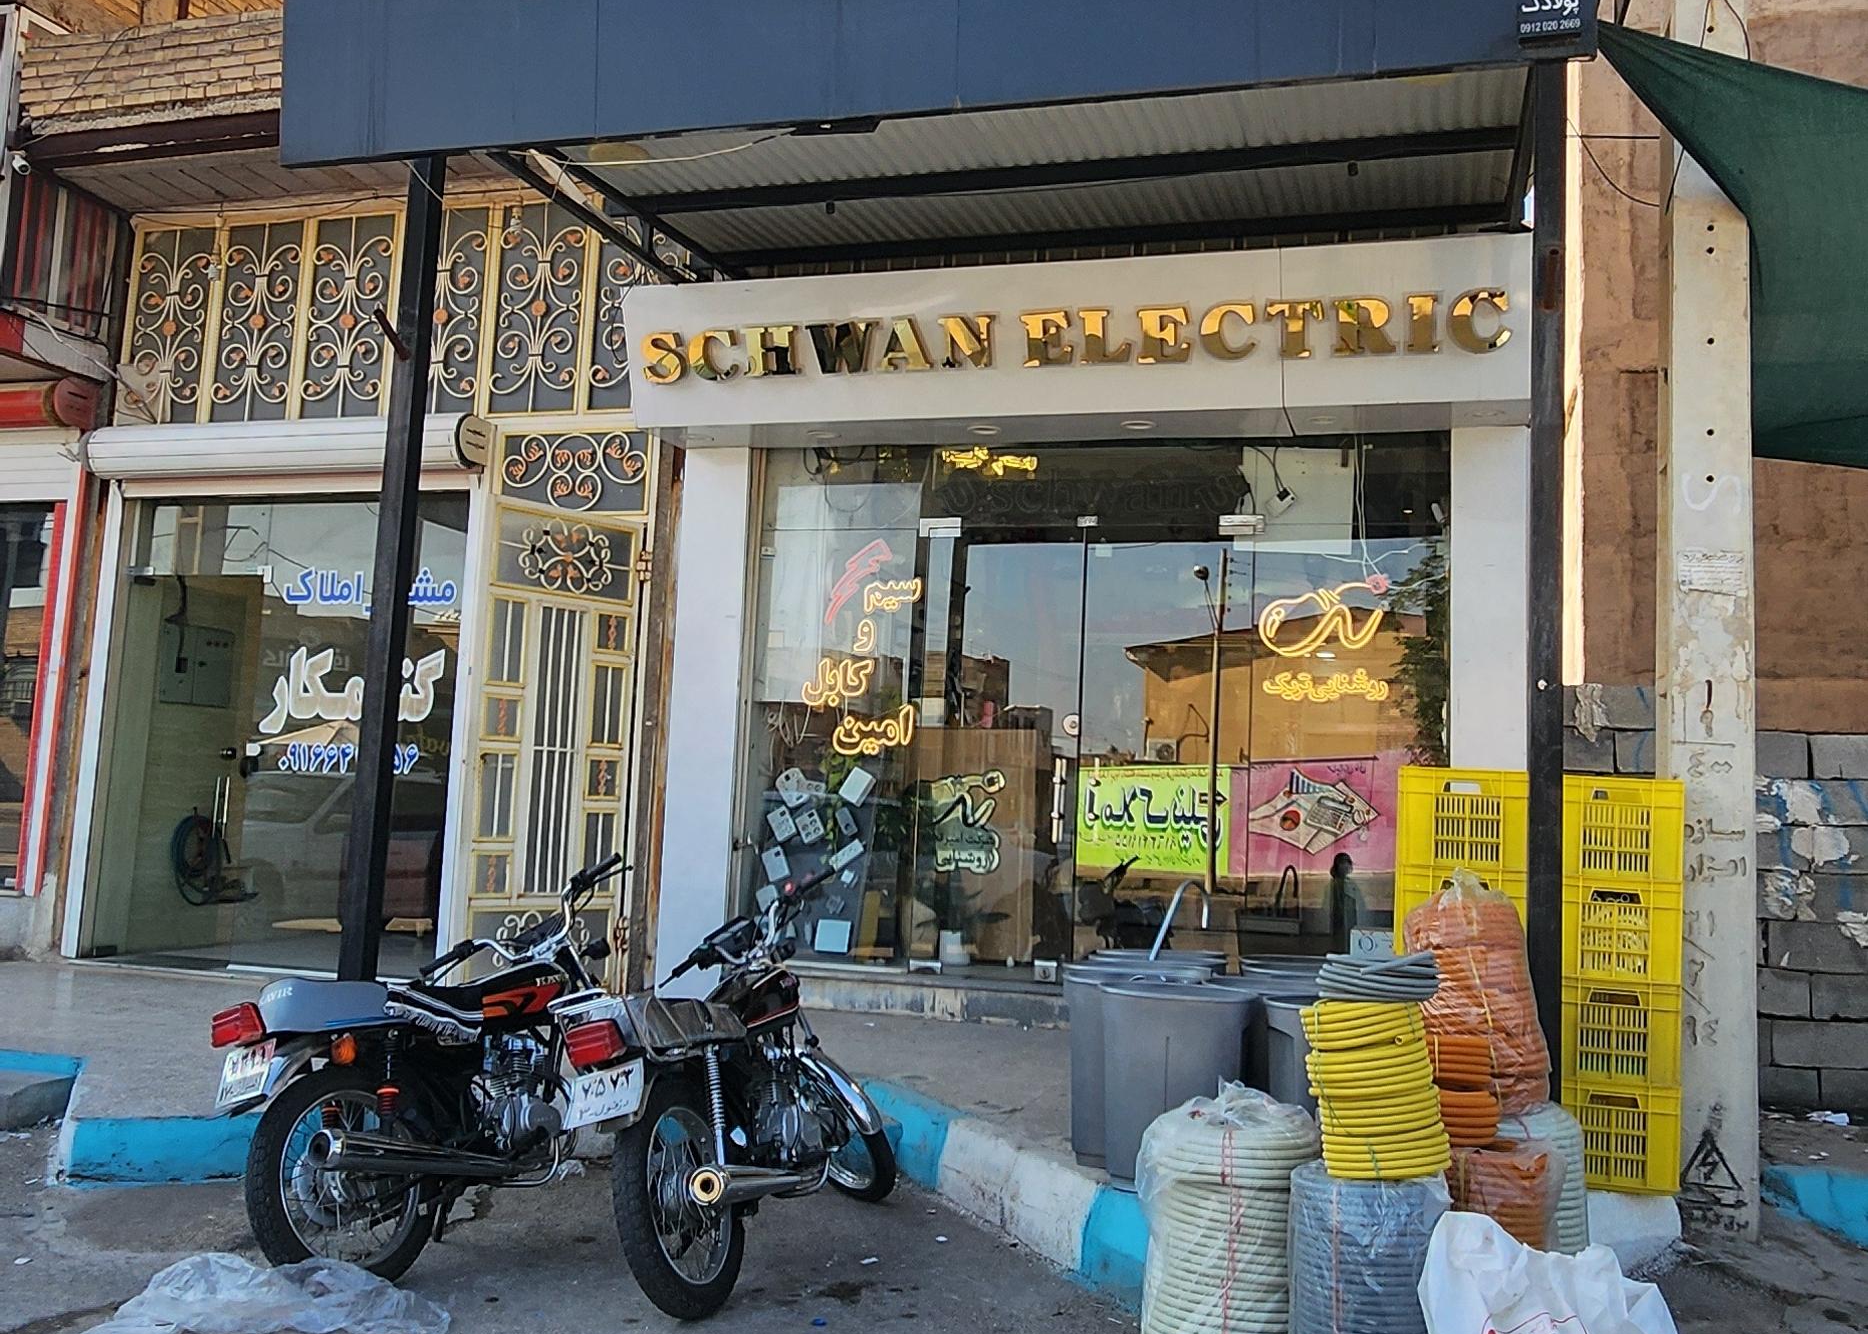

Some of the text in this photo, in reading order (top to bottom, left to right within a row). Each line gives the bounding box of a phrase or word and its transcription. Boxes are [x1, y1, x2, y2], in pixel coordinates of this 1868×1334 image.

[1520, 22, 1541, 34] 0912
[1542, 20, 1558, 32] 020
[640, 286, 1513, 386] SCHWAN ELECTRIC
[284, 567, 364, 605] املاک
[864, 577, 922, 615] سیم
[853, 618, 877, 652] و
[258, 646, 446, 734] گنمکار
[802, 658, 875, 708] کابل
[833, 703, 915, 756] امین
